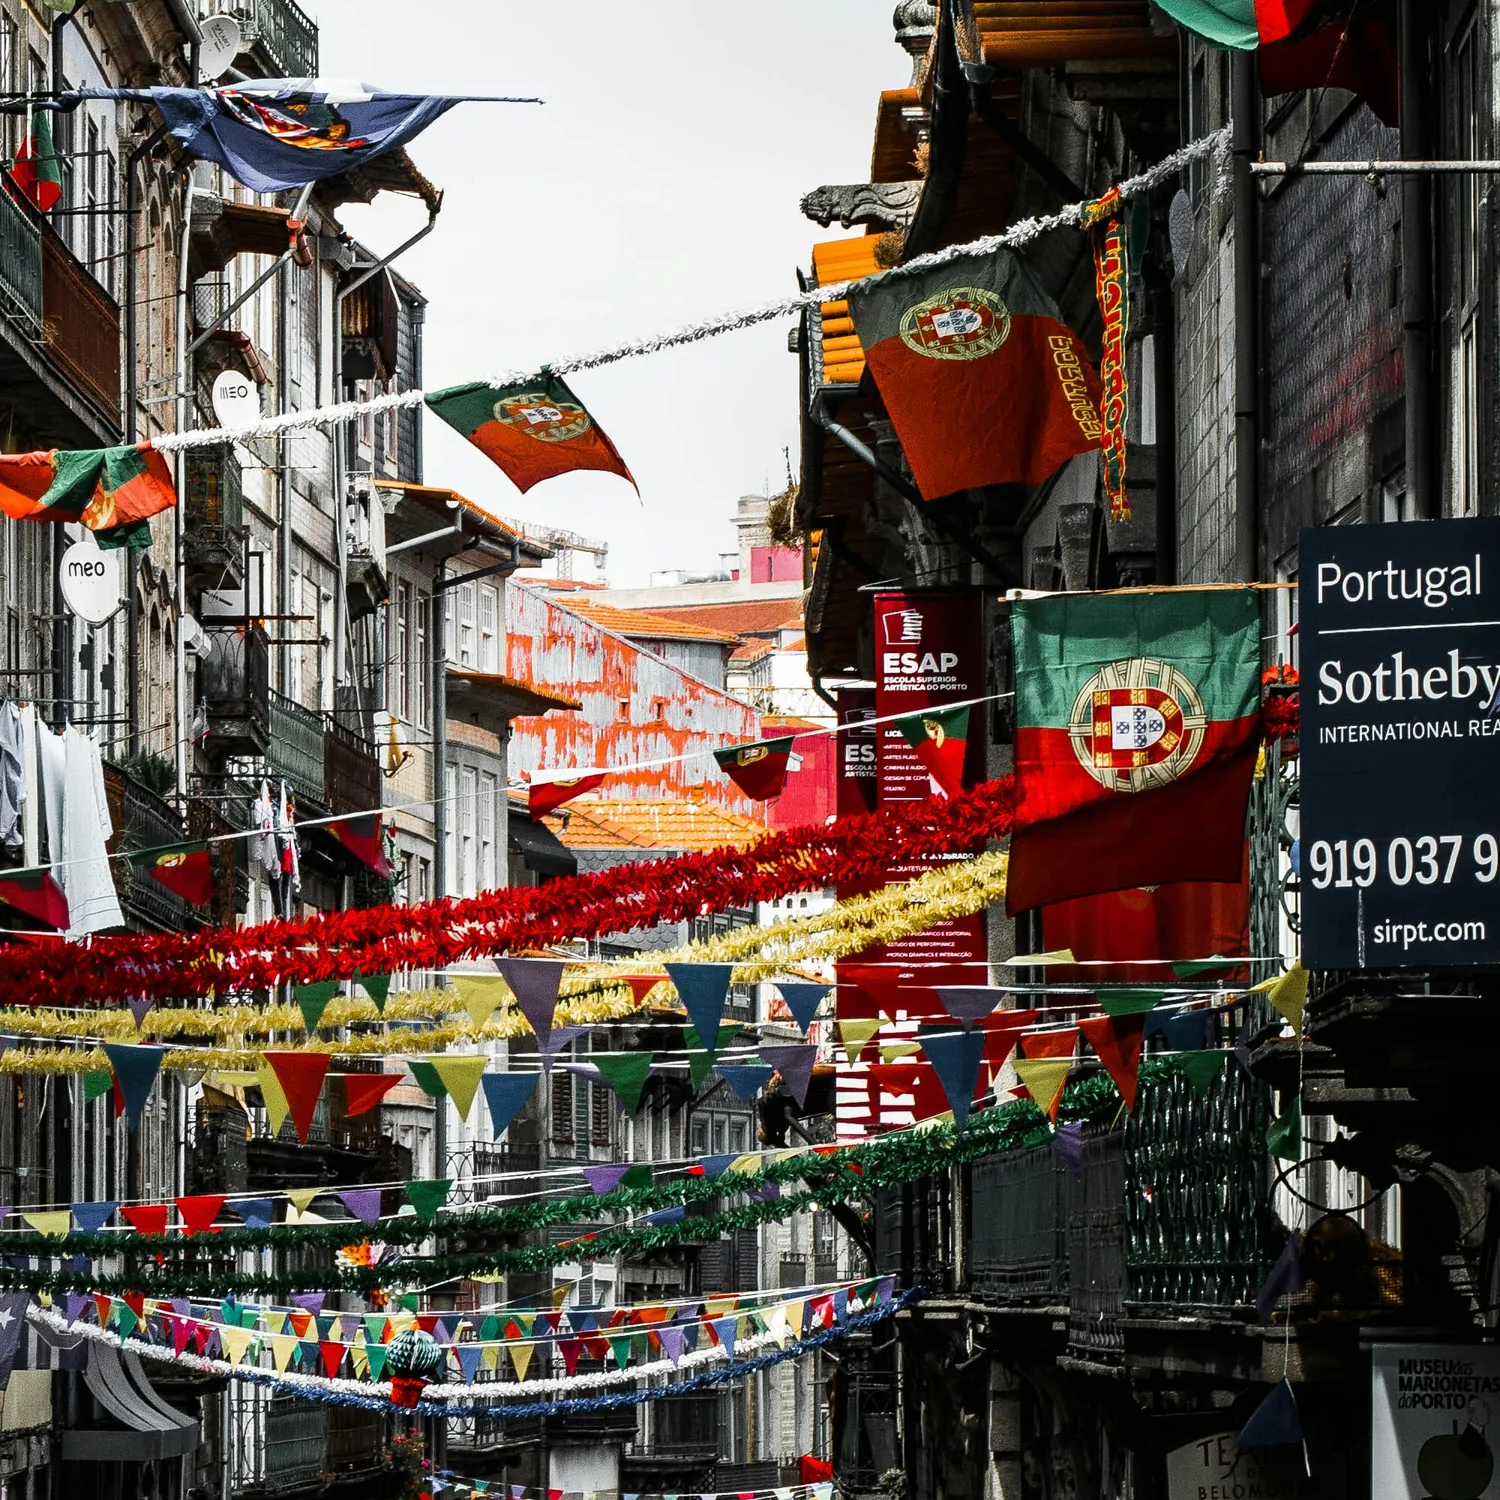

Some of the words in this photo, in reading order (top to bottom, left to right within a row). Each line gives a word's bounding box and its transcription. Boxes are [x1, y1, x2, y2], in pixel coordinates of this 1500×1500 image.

[69, 561, 105, 577] meo
[1318, 554, 1482, 607] Portugal
[883, 652, 959, 674] ESAP
[883, 676, 916, 684] ESCOLA
[883, 683, 926, 691] ARTÍSTICA
[1319, 720, 1463, 744] INTERNATIONAL
[845, 744, 877, 762] ES
[1310, 838, 1377, 889] 919
[1387, 835, 1463, 886] 037
[1473, 833, 1498, 883] 9
[1373, 919, 1485, 950] sirpt.com
[1398, 1375, 1500, 1393] MARIONETAS
